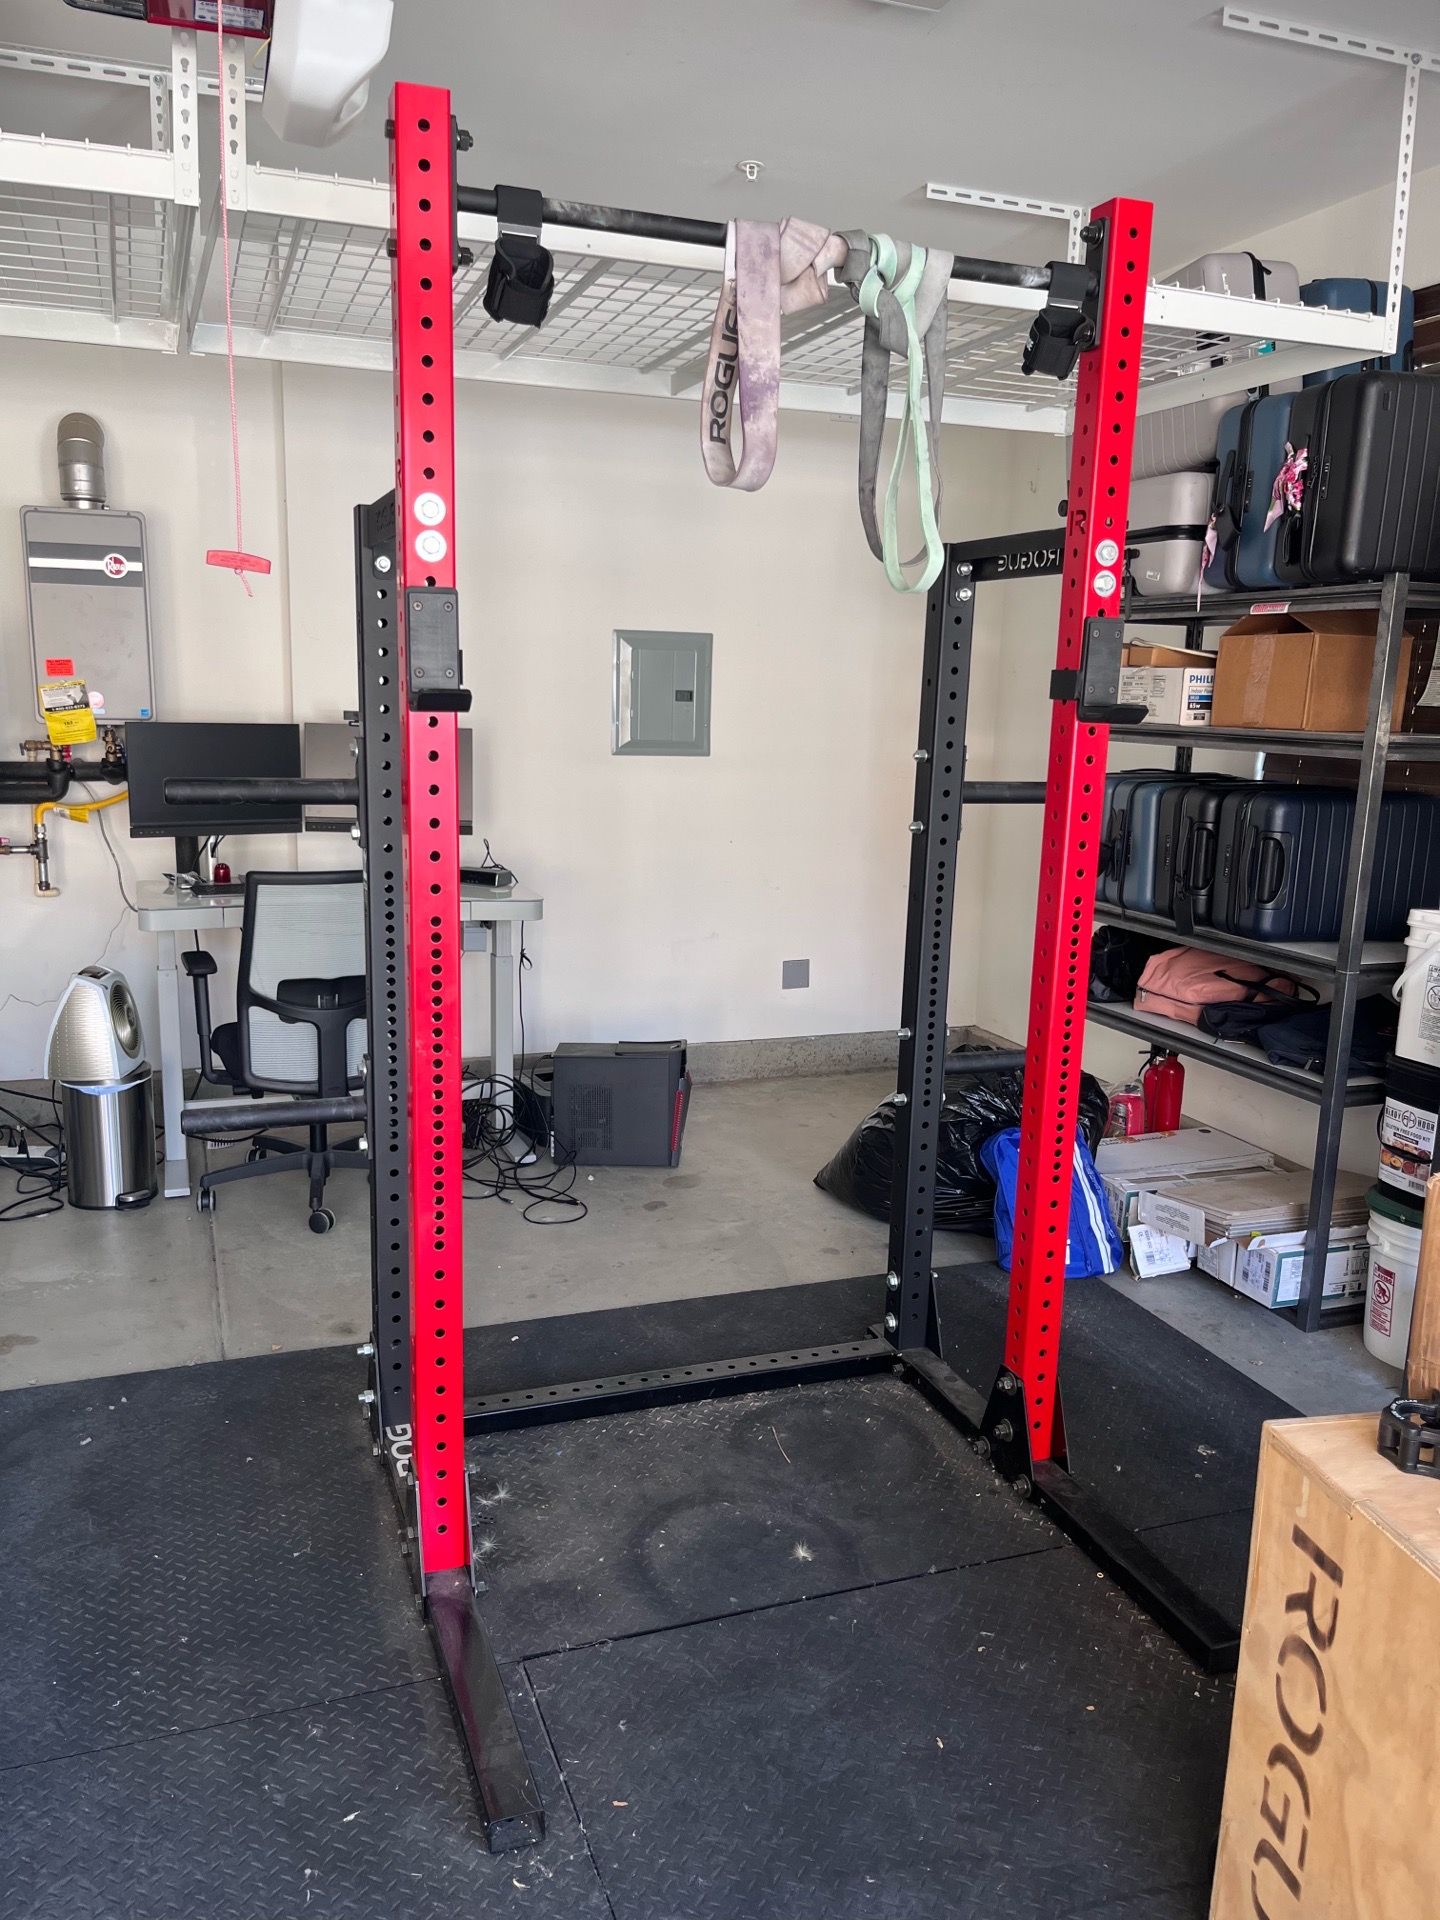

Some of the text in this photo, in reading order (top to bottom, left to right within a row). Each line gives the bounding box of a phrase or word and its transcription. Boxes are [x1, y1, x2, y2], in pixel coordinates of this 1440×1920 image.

[710, 309, 738, 445] ROGUE
[1069, 509, 1087, 536] R
[1190, 675, 1214, 683] PHILI
[385, 1423, 413, 1478] ROG
[1251, 1523, 1344, 1920] ROGU
